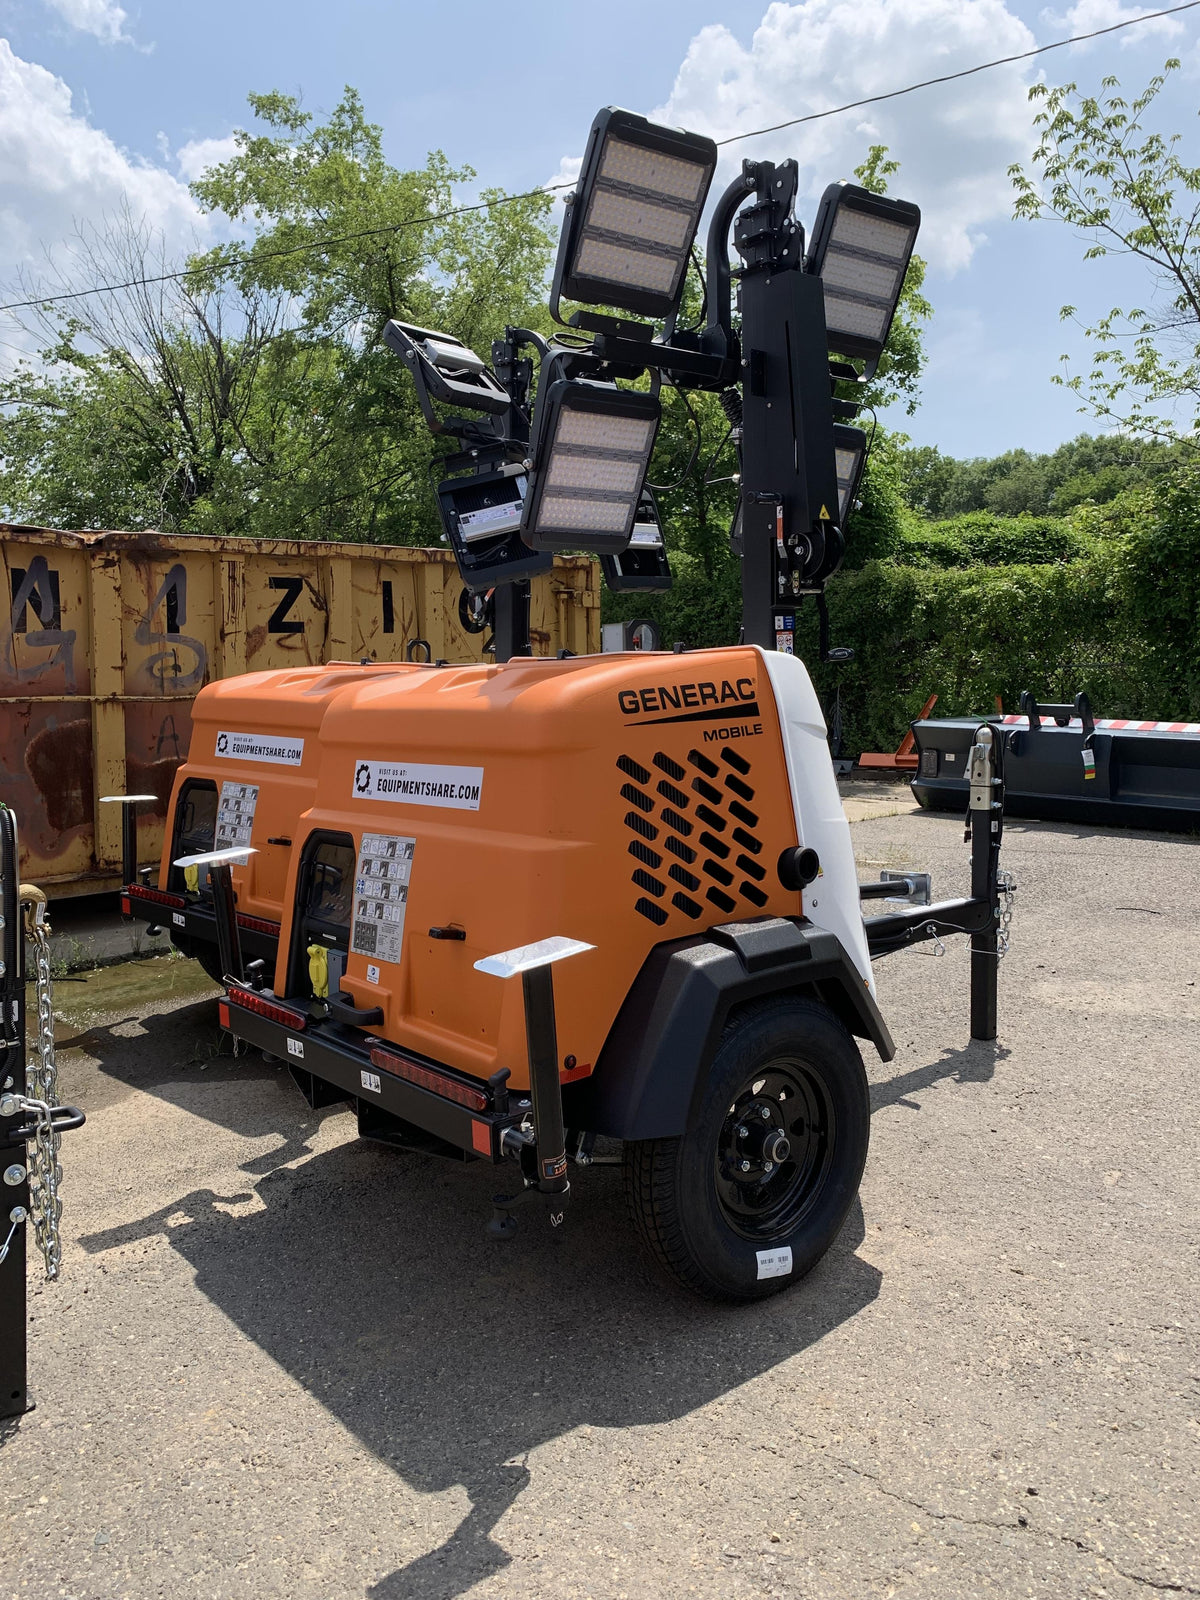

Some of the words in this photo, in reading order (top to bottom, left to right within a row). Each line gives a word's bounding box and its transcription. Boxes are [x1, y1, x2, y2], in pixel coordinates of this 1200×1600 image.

[618, 678, 756, 714] GENERAC
[703, 724, 763, 742] MOBILE
[232, 743, 301, 760] EQUIPMENTSHARE.COM
[379, 768, 391, 776] VISIT
[377, 778, 480, 800] EQUIPMENTSHARE.COM
